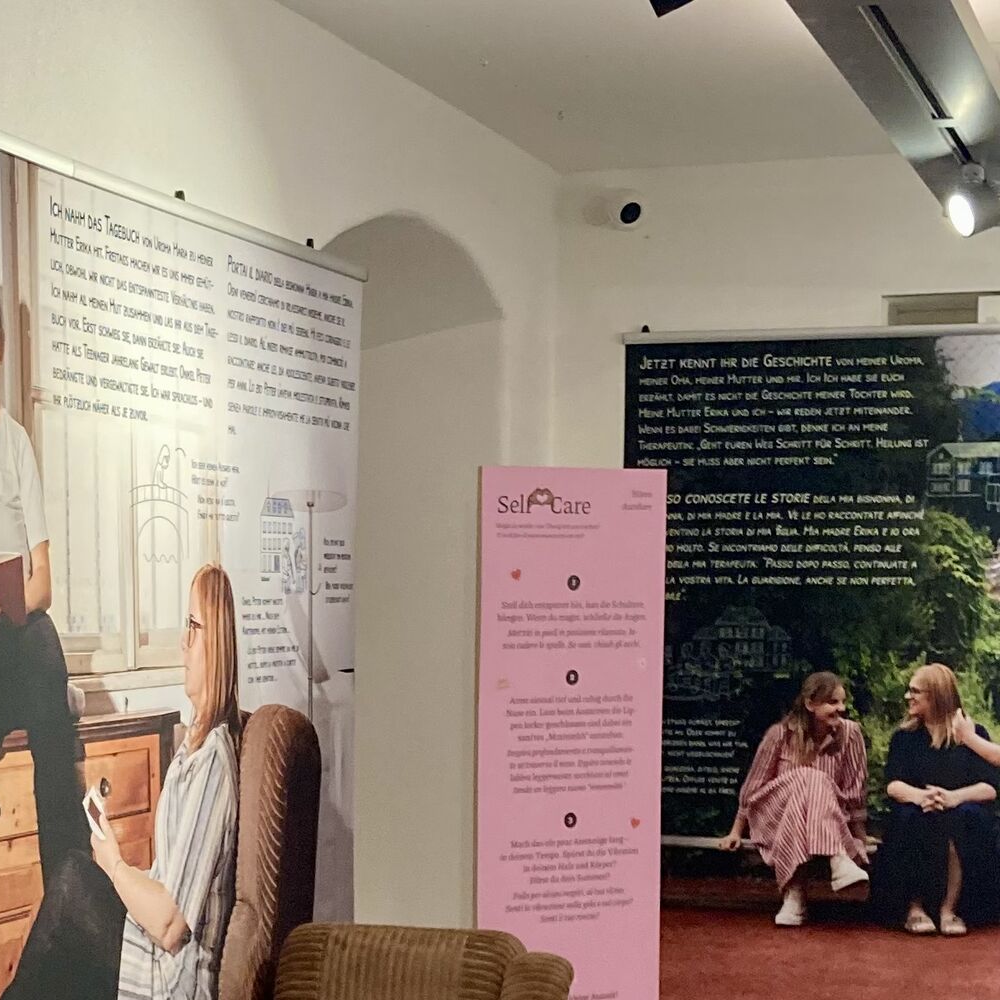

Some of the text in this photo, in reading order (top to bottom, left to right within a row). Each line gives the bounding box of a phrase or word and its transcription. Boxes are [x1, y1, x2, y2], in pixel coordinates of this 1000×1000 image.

[50, 195, 62, 219] ICH
[64, 208, 86, 226] NAHM
[88, 214, 102, 232] DAS
[104, 215, 140, 244] TAGEBUCH
[640, 356, 676, 370] JETZT
[680, 358, 716, 369] KENNT
[720, 357, 738, 368] IHR
[742, 357, 758, 368] DIE
[764, 354, 832, 367] GESCHICHTE
[497, 493, 592, 514] Self Care
[685, 493, 752, 504] CONOSCETE
[754, 493, 768, 504] LE
[771, 493, 810, 504] STORIE
